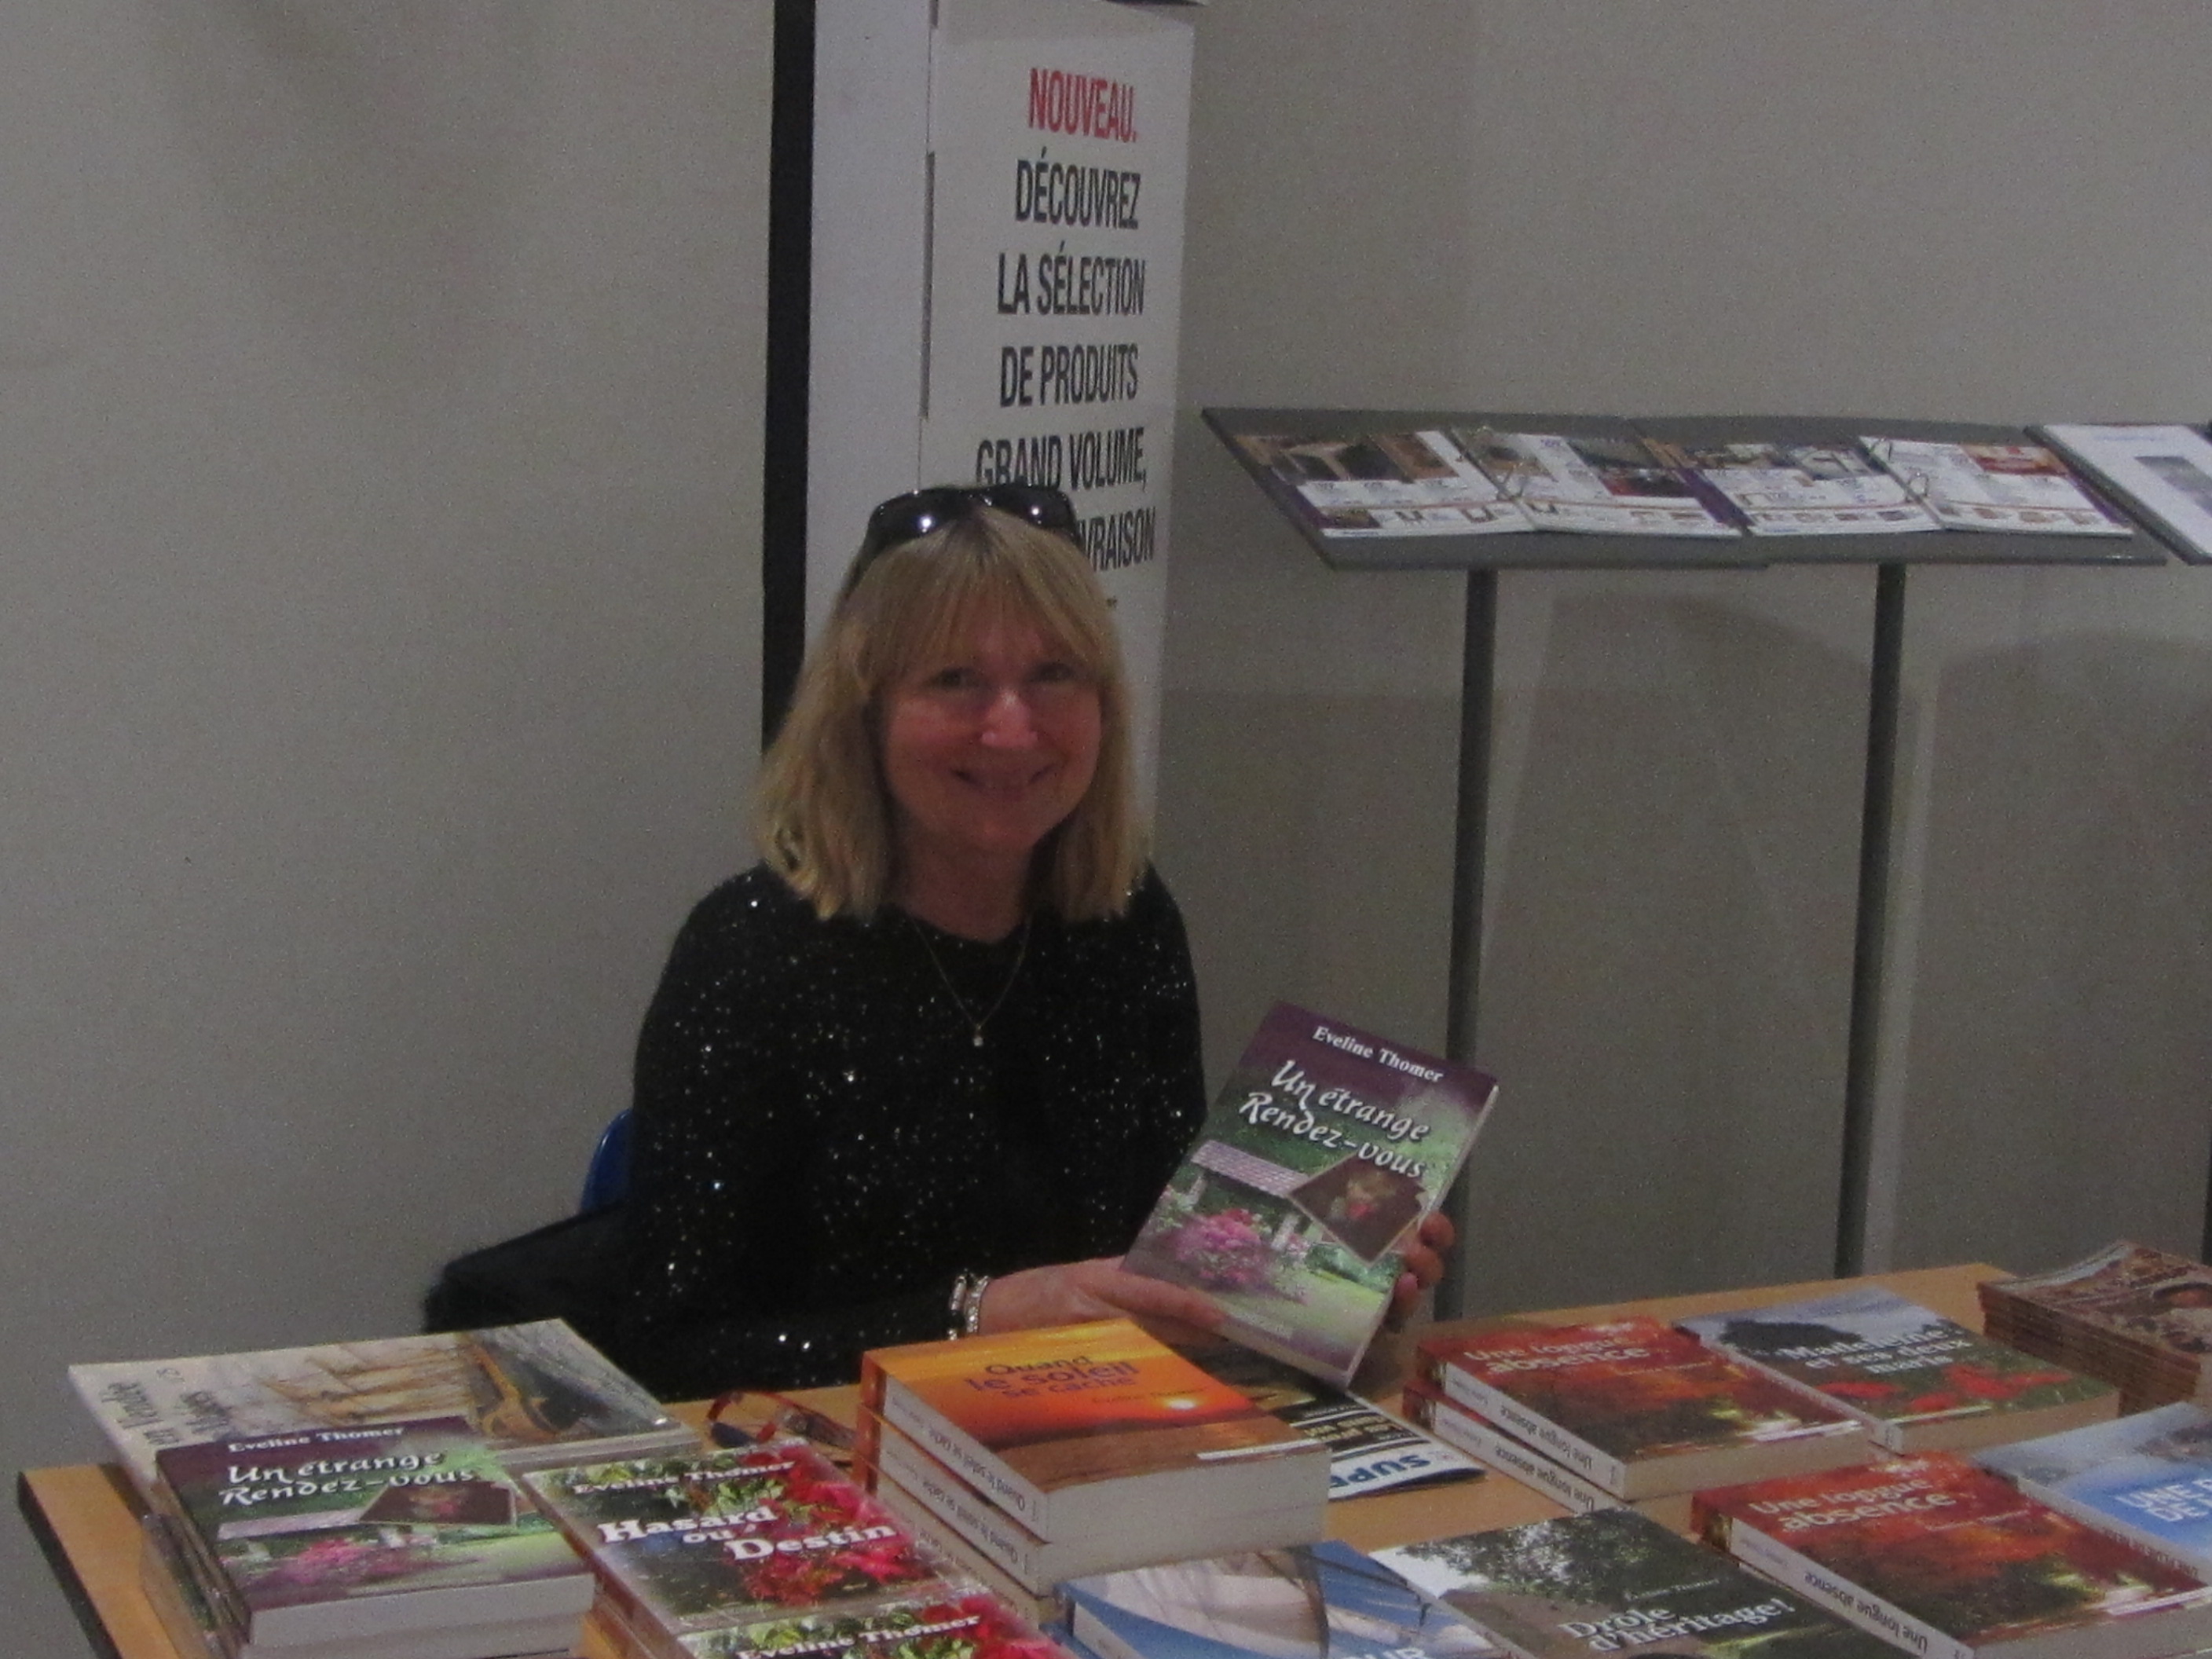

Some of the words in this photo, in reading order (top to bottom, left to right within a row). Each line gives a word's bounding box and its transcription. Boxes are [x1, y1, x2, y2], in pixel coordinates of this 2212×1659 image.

[1028, 68, 1136, 143] NOUVEAU.
[1015, 146, 1141, 229] DÉCOUVREZ
[998, 253, 1031, 314] LA
[1037, 240, 1145, 315] SÉLECTION
[1000, 346, 1034, 408] DE
[1040, 343, 1138, 405] PRODUITS
[976, 435, 1062, 487] GRAND
[1070, 427, 1146, 491] VOLUME,
[1312, 1025, 1373, 1059] Eveline
[1379, 1047, 1444, 1083] Thomer
[1271, 1060, 1316, 1110] Un
[1318, 1087, 1431, 1142] étrange
[1239, 1092, 1426, 1178] Rendez-vous
[964, 1375, 1012, 1393] le
[1020, 1361, 1141, 1385] soleil
[984, 1355, 1094, 1377] Quand
[1486, 1347, 1650, 1373] absence
[1049, 1375, 1137, 1395] cache
[228, 1435, 312, 1453] Eveline
[316, 1426, 405, 1442] Thomer
[218, 1469, 476, 1506] Rendez-vous
[227, 1465, 291, 1485] Un
[1747, 1496, 1822, 1515] Une
[1820, 1478, 1934, 1504] longue
[1777, 1491, 1958, 1533] absence
[596, 1506, 780, 1544] Hasard
[681, 1528, 738, 1544] ou
[723, 1525, 899, 1562] Destin
[1804, 1571, 1855, 1609] absence
[1856, 1598, 1900, 1639] longue
[1901, 1624, 1928, 1650] Une
